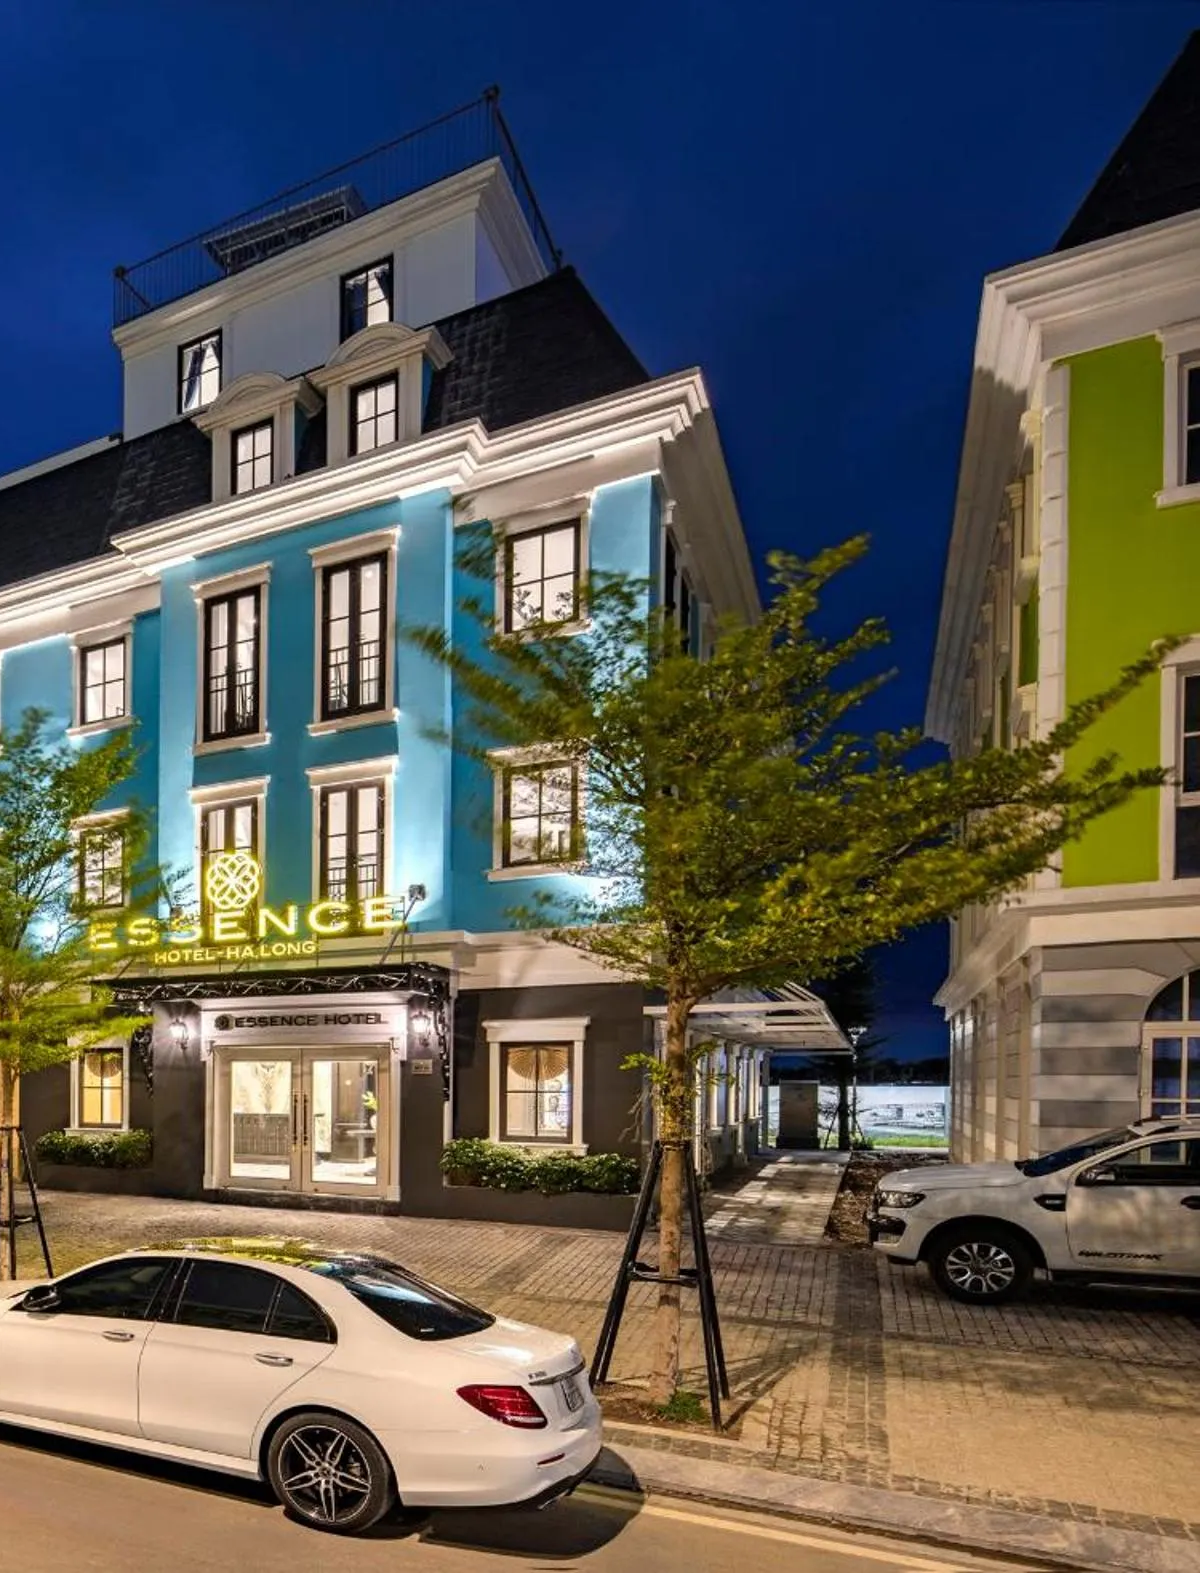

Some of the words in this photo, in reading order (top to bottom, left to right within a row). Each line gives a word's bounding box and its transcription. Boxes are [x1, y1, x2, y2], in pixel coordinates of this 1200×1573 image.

[89, 896, 404, 949] ESSENCE
[235, 1014, 317, 1028] ESSENCE
[324, 1012, 389, 1025] HOTEL
